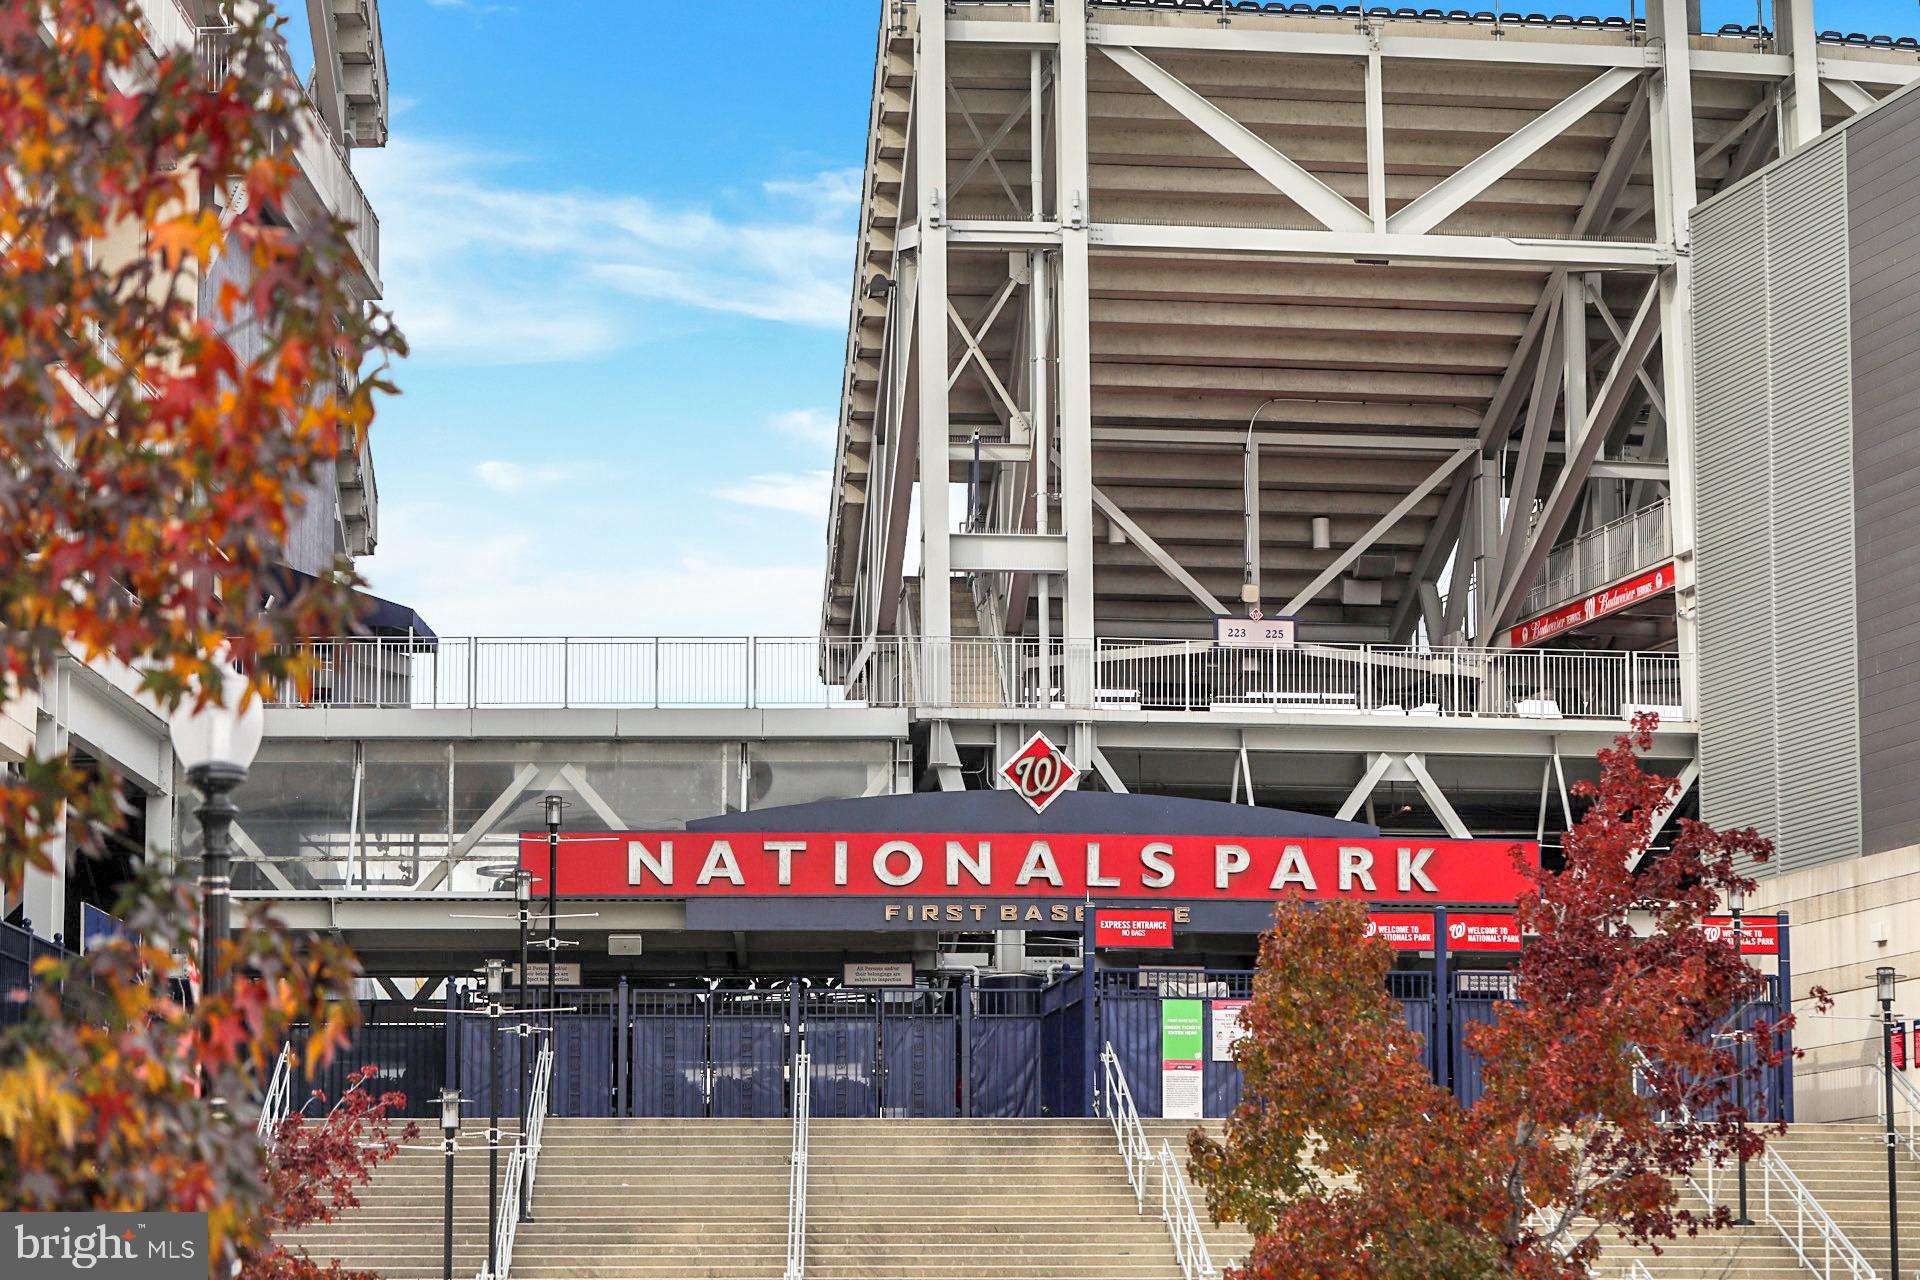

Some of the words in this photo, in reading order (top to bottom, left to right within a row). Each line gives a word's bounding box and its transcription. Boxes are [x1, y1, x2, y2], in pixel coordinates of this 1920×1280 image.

[1598, 588, 1636, 613] Budweiser
[1531, 616, 1566, 640] Budweiser
[1227, 628, 1246, 637] 223
[1265, 629, 1284, 639] 225
[626, 840, 1177, 888] NATIONALS
[1214, 844, 1440, 893] PARK
[885, 904, 987, 921] FIRST
[1100, 920, 1131, 929] EXPRESS
[1132, 921, 1167, 930] ENTRANCE
[1378, 925, 1409, 934] WELCOME
[1411, 926, 1419, 934] TO
[1131, 929, 1146, 937] BAGS
[1467, 926, 1499, 935] WELCOME
[1500, 927, 1508, 935] TO
[1754, 930, 1763, 938] TO
[1382, 933, 1412, 942] ATIONALS
[1467, 934, 1502, 942] NATIONALS
[1502, 935, 1520, 943] PARK
